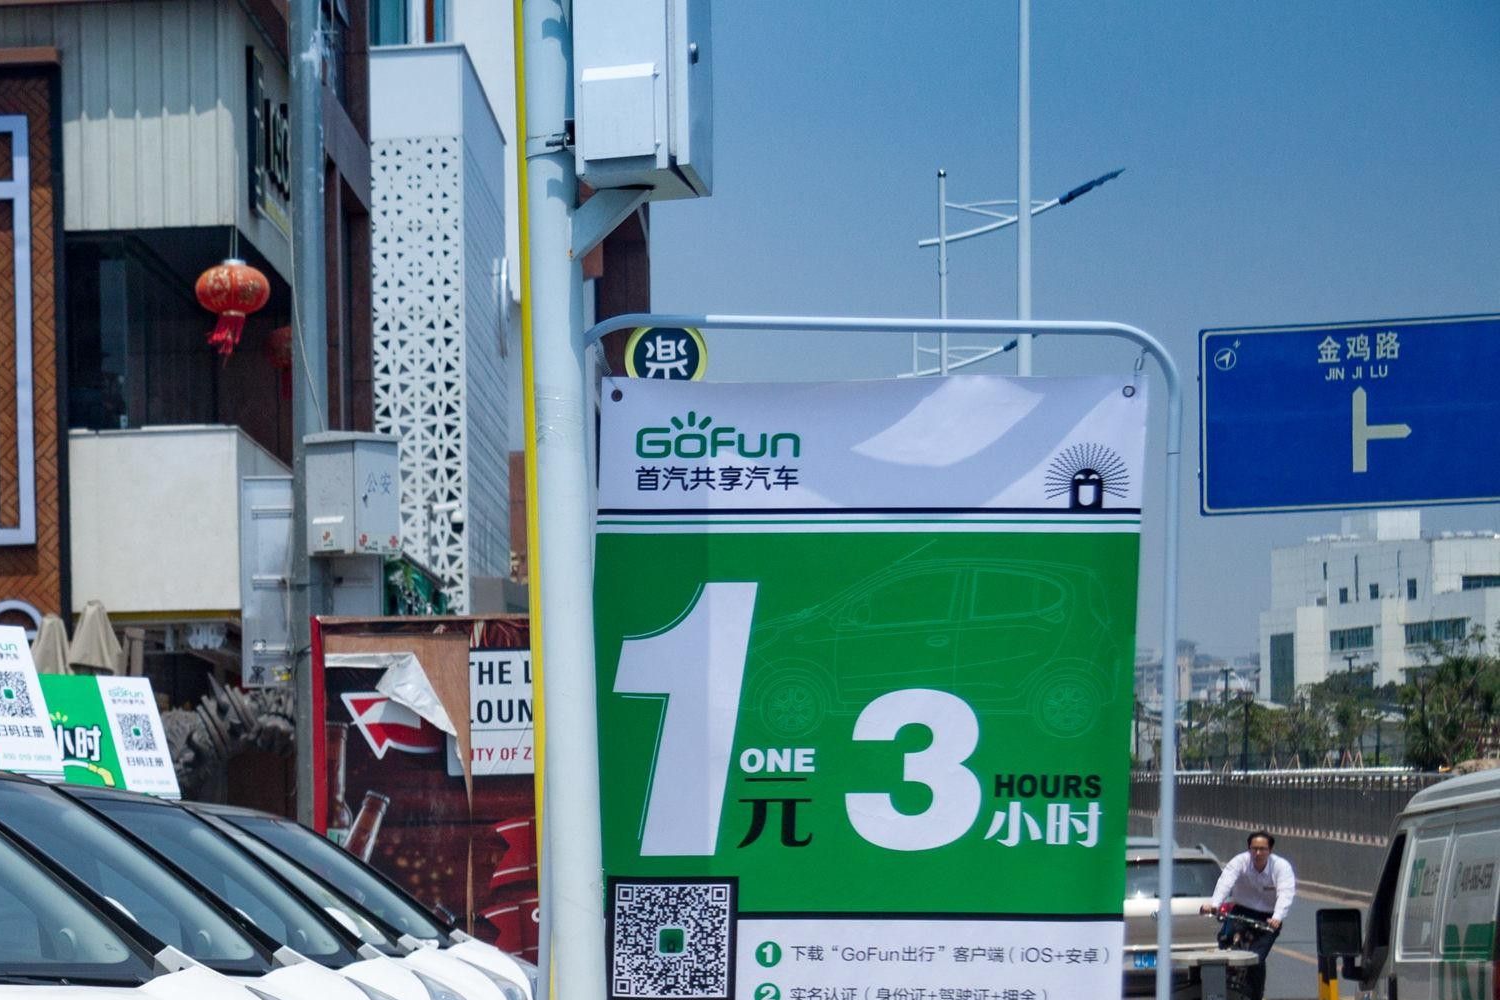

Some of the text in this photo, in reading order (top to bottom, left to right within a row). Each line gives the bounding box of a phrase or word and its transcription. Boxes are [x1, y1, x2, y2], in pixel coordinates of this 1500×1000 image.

[1318, 331, 1400, 364] 金鸡路
[1325, 365, 1388, 381] JIN JI LU
[635, 411, 800, 459] GoFun
[636, 466, 800, 491] 首汽共享汽车
[470, 699, 533, 724] OUN
[613, 582, 759, 856] 1
[500, 747, 518, 761] OF
[739, 748, 815, 773] ONE
[845, 688, 983, 851] 3
[994, 774, 1102, 799] HOURS
[737, 777, 813, 849] 元
[984, 801, 1103, 849] 小时
